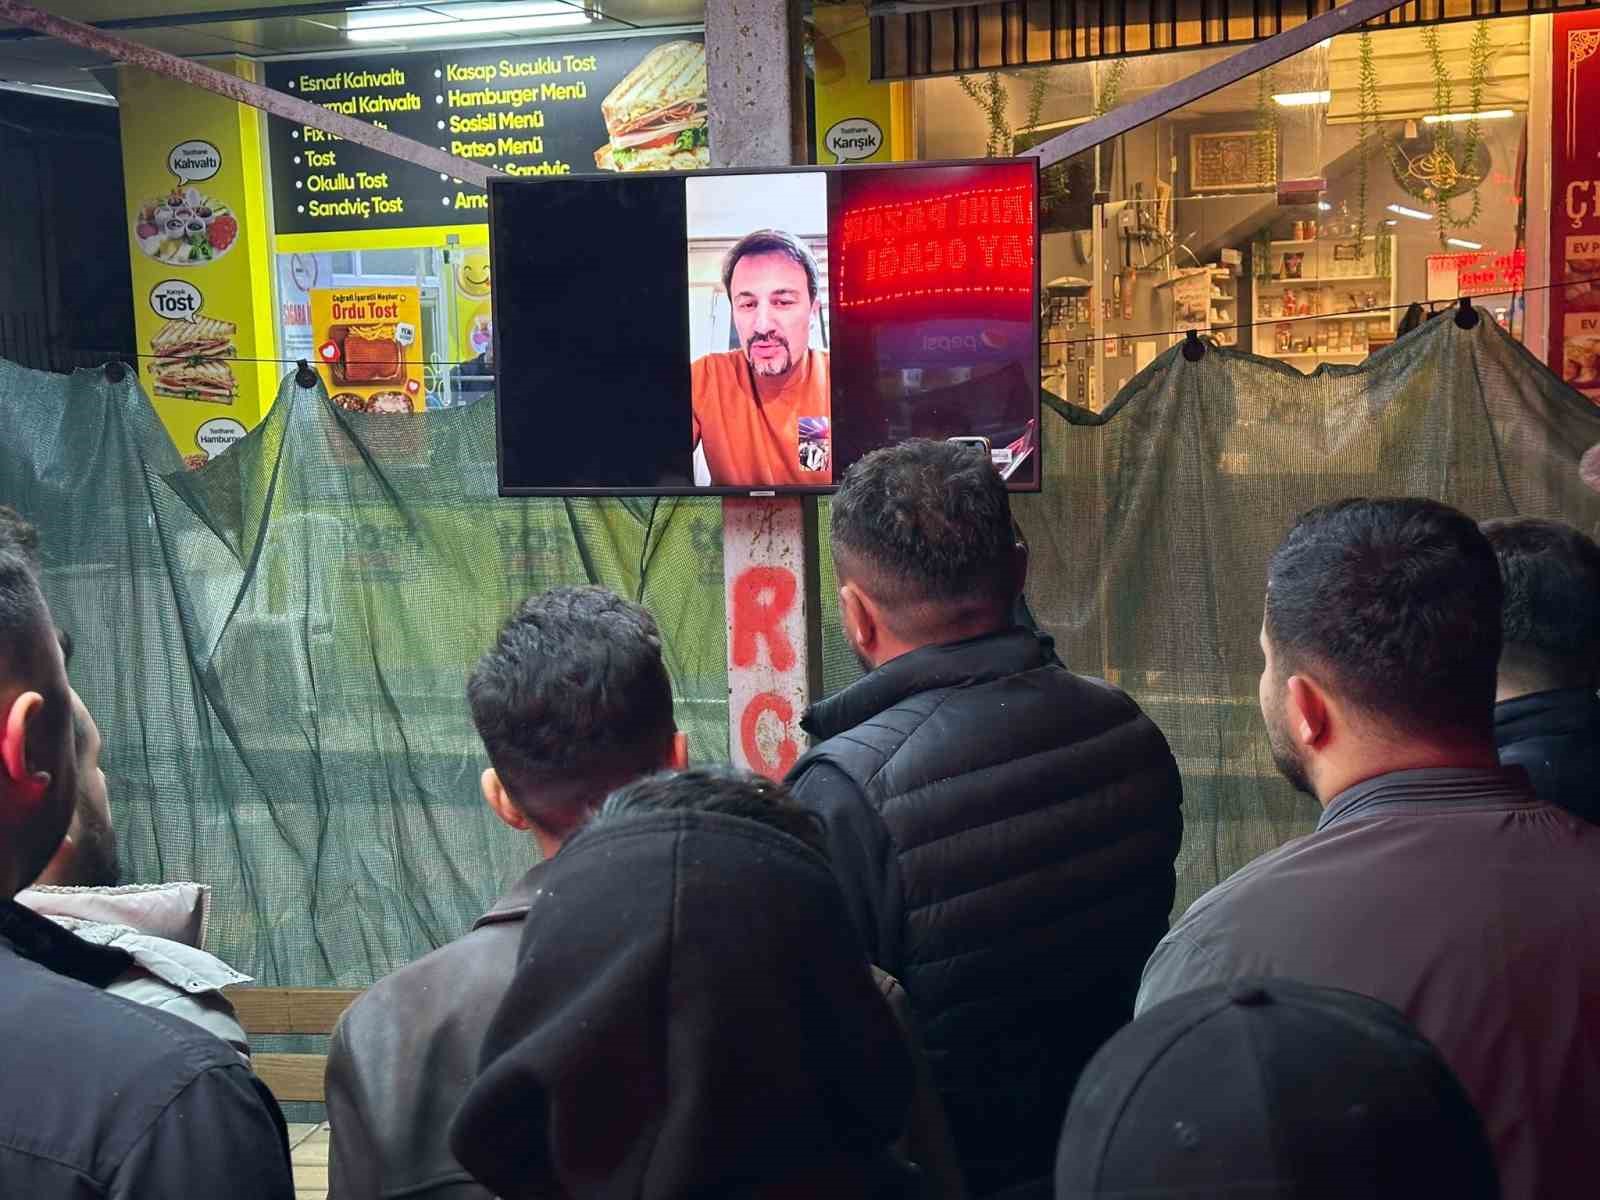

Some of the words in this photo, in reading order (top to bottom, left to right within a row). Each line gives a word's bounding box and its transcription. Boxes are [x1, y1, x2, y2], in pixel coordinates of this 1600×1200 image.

[446, 64, 497, 83] Kasap
[499, 57, 562, 78] Sucuklu
[563, 55, 597, 71] Tost
[300, 73, 342, 92] Esnaf
[343, 68, 405, 89] Kahvaltı
[359, 92, 421, 113] Kahvaltı
[448, 87, 539, 107] Hamburger
[540, 81, 587, 101] Menü
[450, 112, 497, 133] Sosisli
[499, 110, 545, 130] Menü
[451, 140, 496, 158] Patso
[497, 136, 544, 156] Menü
[833, 134, 876, 151] Karışık
[174, 156, 217, 169] Kahvaltı
[304, 151, 336, 168] Tost
[307, 173, 355, 192] Okullu
[356, 172, 388, 189] Tost
[308, 197, 370, 219] Sandviç
[370, 196, 403, 213] Tost
[1573, 242, 1590, 254] EV
[154, 293, 196, 312] Tost
[332, 303, 365, 320] Ordu
[367, 301, 398, 319] Tost
[1580, 319, 1597, 329] EV
